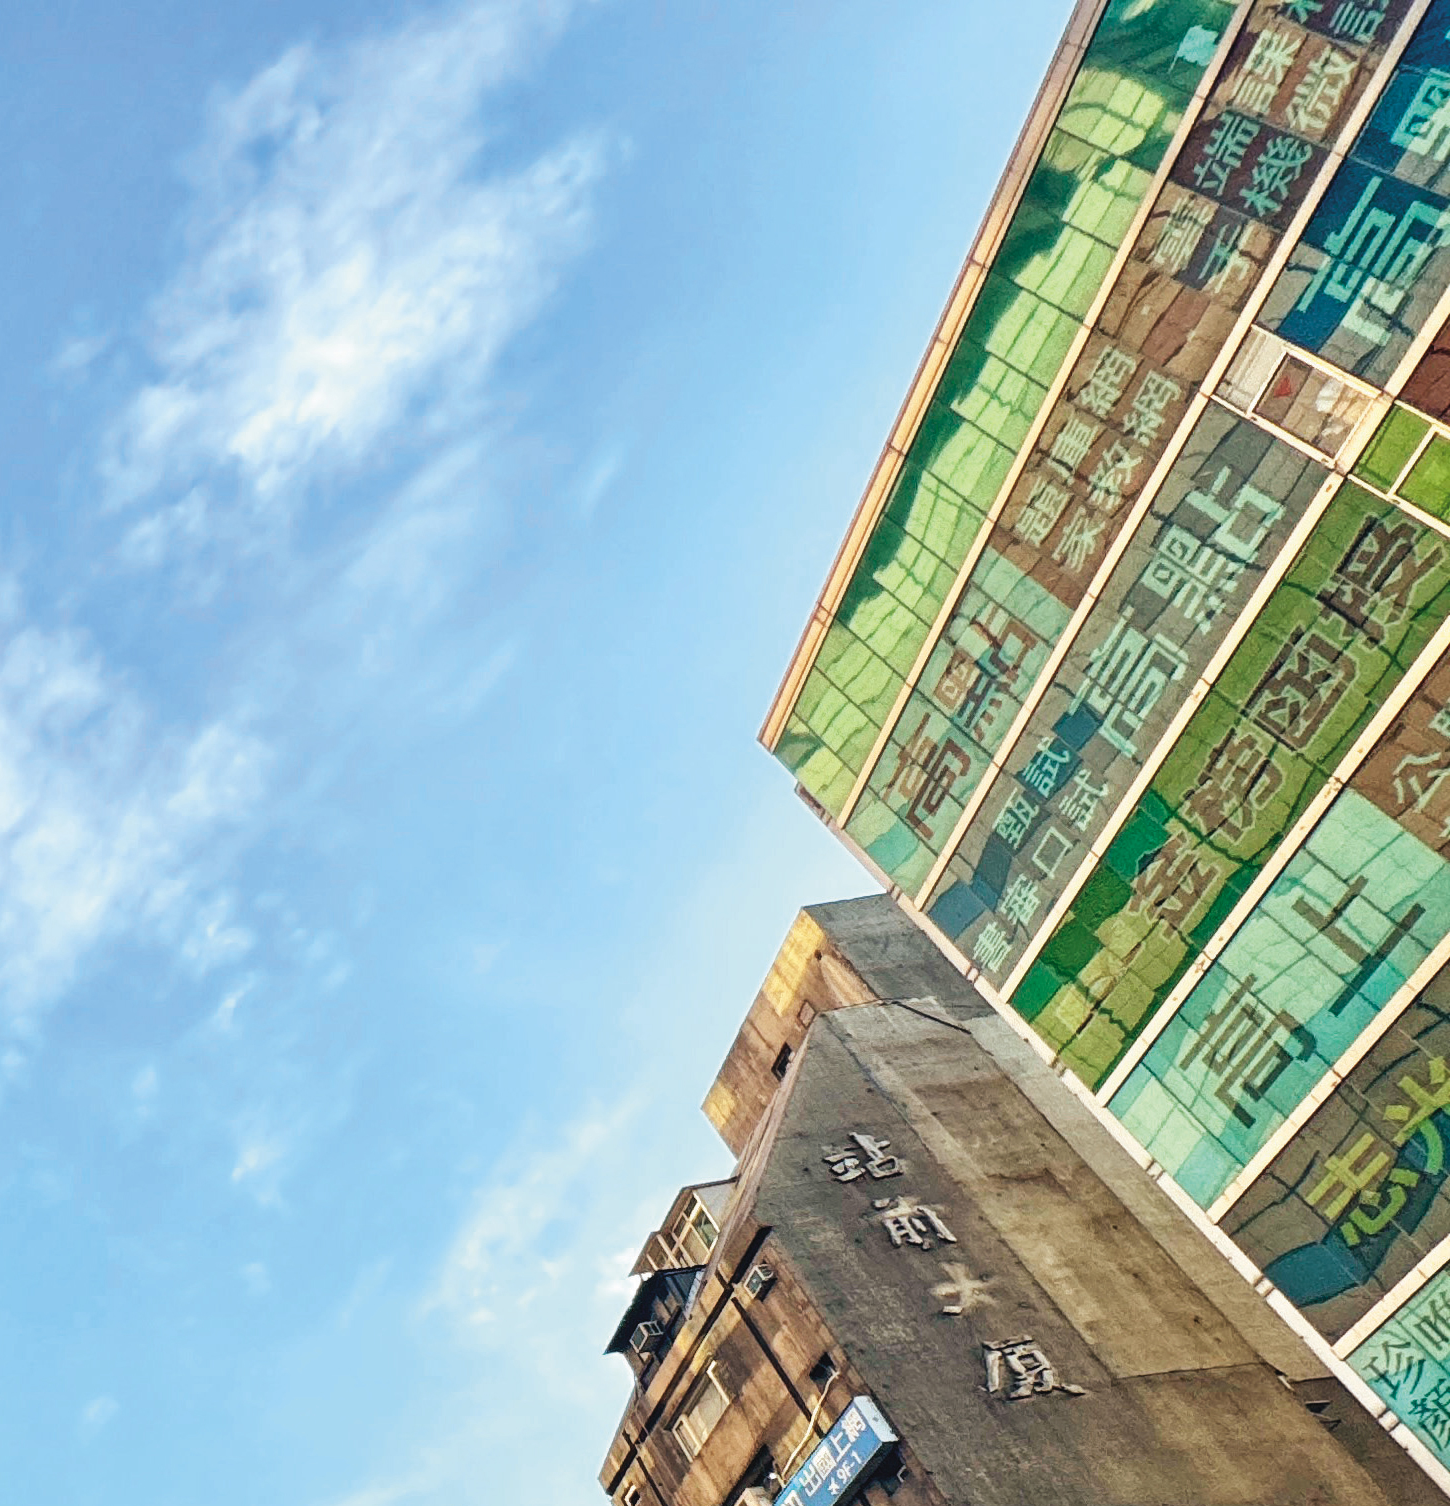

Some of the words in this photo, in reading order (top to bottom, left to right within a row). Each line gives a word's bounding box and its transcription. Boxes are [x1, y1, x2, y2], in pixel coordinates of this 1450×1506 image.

[1013, 344, 1138, 546] 題庫網
[1053, 368, 1184, 573] 家教網
[1069, 465, 1287, 758] 高點
[881, 605, 1037, 840] 高點
[993, 733, 1073, 851] 甄試
[1127, 511, 1448, 938] 金榜函授
[972, 766, 1110, 972] 書審口試
[1177, 874, 1426, 1129] 高上
[1308, 1056, 1450, 1246] 志光
[800, 1405, 867, 1497] 出國上網
